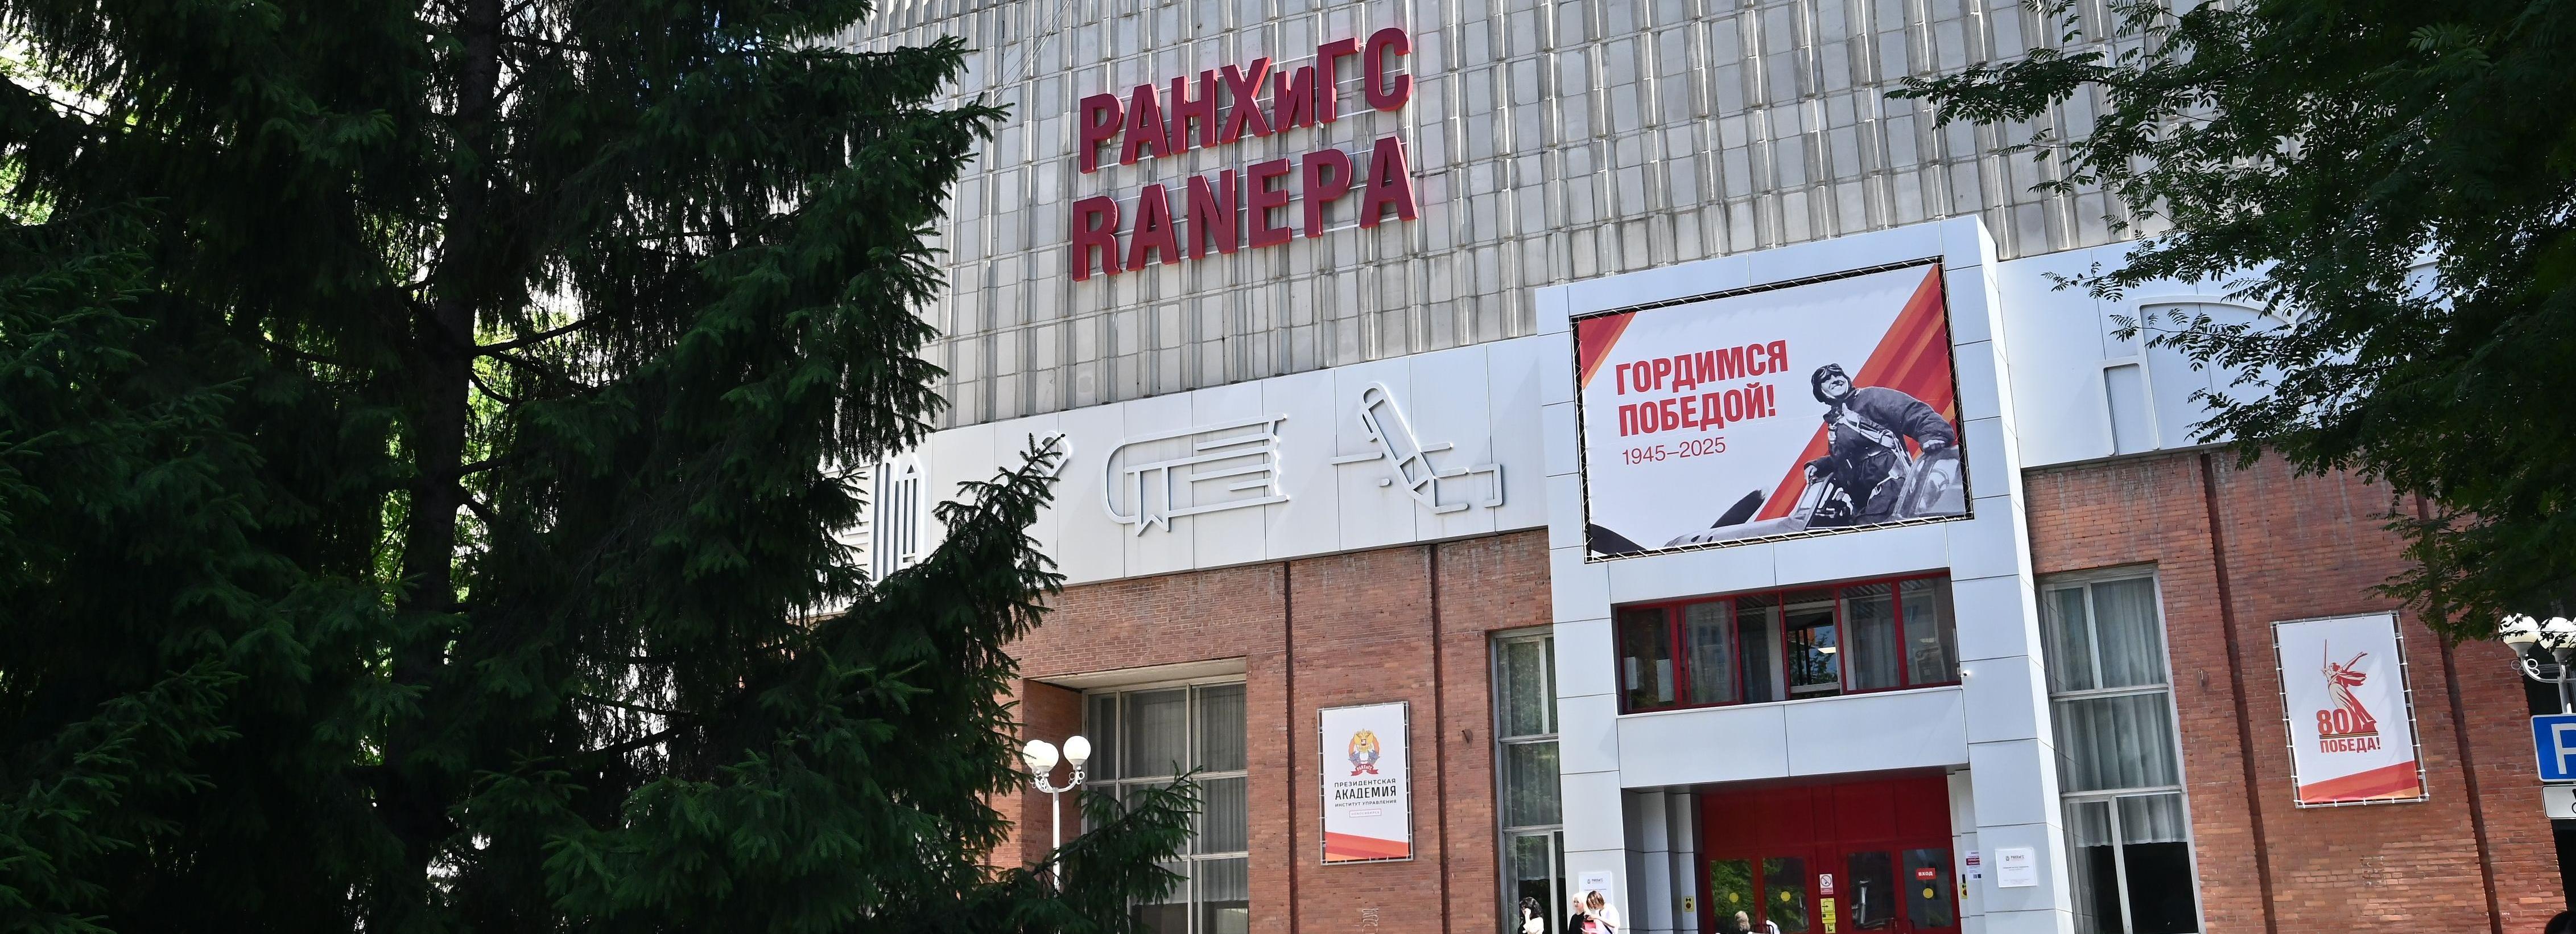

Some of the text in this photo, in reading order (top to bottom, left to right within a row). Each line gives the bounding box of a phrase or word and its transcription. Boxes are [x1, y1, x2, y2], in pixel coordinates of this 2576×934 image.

[1080, 27, 1413, 174] РАНХиГС
[1072, 136, 1418, 282] RANEPA
[1616, 340, 1788, 395] ГОРДИМСЯ
[1619, 382, 1776, 437] ПОБЕДОЙ!
[2317, 709, 2350, 734] 80
[2320, 737, 2380, 753] ПОБЕДА!
[2551, 723, 2576, 774] P
[1334, 778, 1396, 787] ПРЕЗИДЕНТСКАЯ
[1335, 785, 1396, 800] АКАДЕМИЯ
